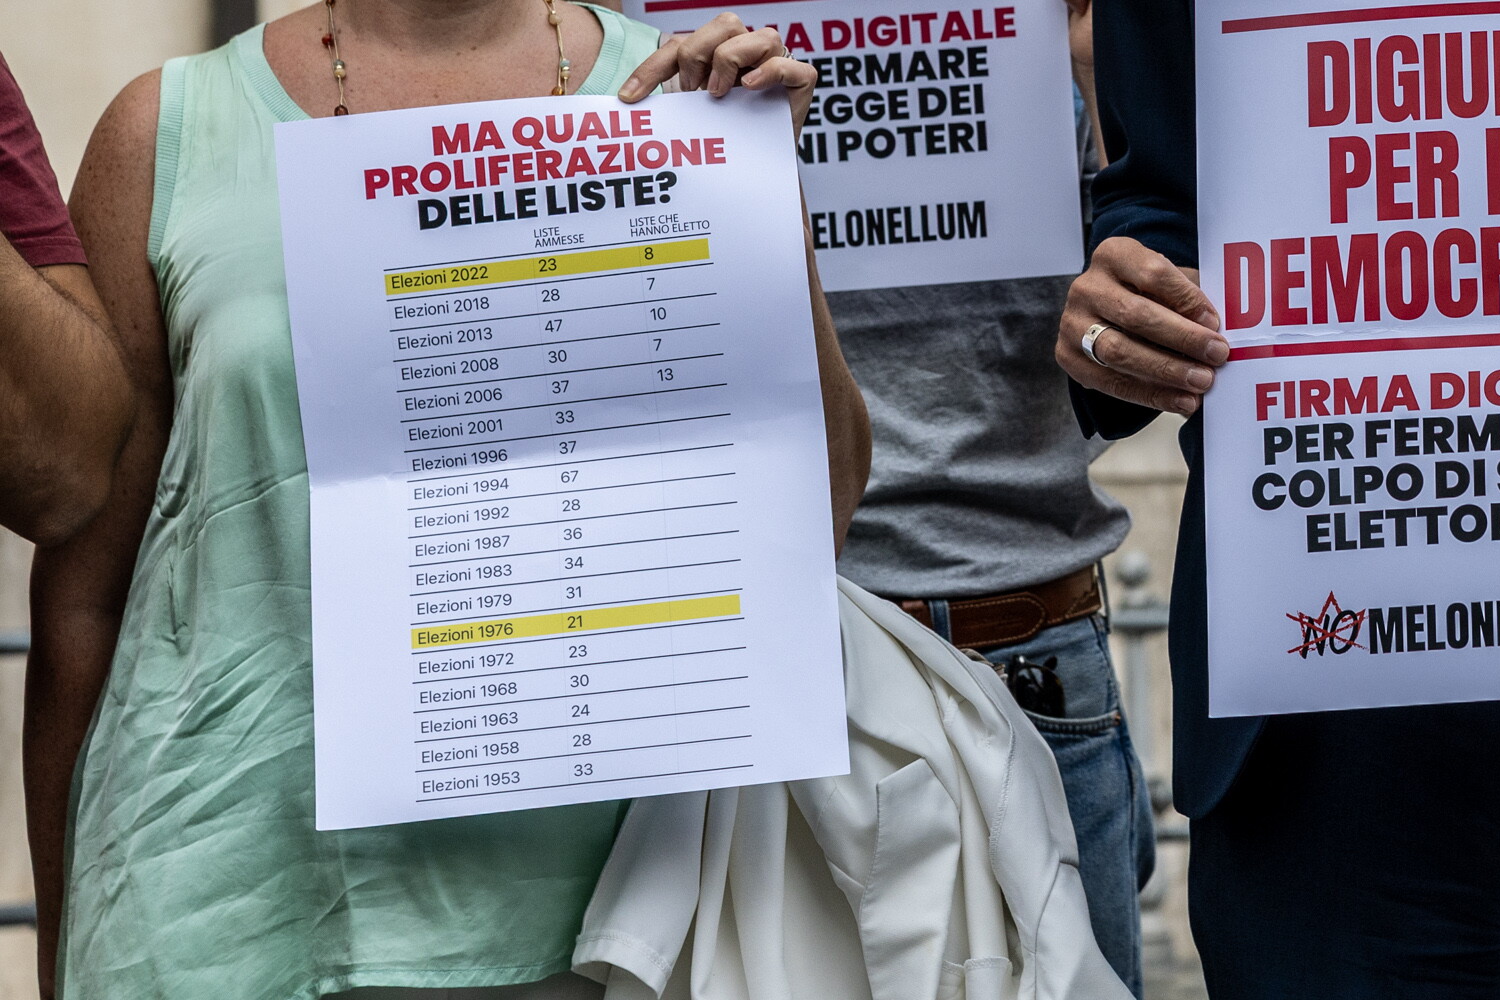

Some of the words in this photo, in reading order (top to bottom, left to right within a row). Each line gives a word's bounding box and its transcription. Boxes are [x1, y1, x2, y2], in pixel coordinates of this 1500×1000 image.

[822, 6, 1016, 51] DIGITALE
[797, 45, 989, 88] ERMARE
[804, 88, 910, 127] EGGE
[918, 83, 985, 118] DEI
[432, 121, 505, 156] MA
[512, 110, 652, 150] QUALE
[837, 120, 988, 162] POTERI
[364, 138, 726, 200] PROLIFERAZIONE
[1329, 131, 1459, 224] PER
[418, 187, 538, 230] DELLE
[546, 171, 677, 216] LISTE?
[629, 215, 656, 228] LISTE
[657, 213, 680, 225] CHE
[533, 226, 561, 239] LISTE
[534, 233, 585, 249] AMMESSE
[630, 224, 670, 238] HANNO
[671, 219, 710, 233] ELETTO
[811, 201, 988, 250] ELONELLUM
[391, 270, 447, 290] Elezioni
[450, 265, 489, 283] 2022
[538, 257, 558, 273] 23
[643, 246, 655, 261] 8
[394, 300, 450, 320] Elezioni
[453, 296, 490, 313] 2018
[541, 288, 561, 303] 28
[646, 277, 656, 291] 7
[397, 330, 453, 350] Elezioni
[456, 326, 493, 344] 2013
[544, 318, 563, 333] 47
[649, 306, 667, 321] 10
[400, 361, 457, 381] Elezioni
[460, 357, 500, 374] 2008
[547, 349, 568, 364] 30
[652, 338, 662, 352] 7
[404, 391, 460, 411] Elezioni
[463, 387, 503, 405] 2006
[551, 379, 570, 395] 37
[656, 367, 674, 382] 13
[1256, 375, 1420, 421] FIRMA
[408, 422, 464, 442] Elezioni
[467, 418, 503, 435] 2001
[555, 409, 575, 425] 33
[1264, 423, 1354, 465] PER
[411, 452, 468, 472] Elezioni
[470, 448, 508, 465] 1996
[558, 440, 577, 455] 37
[414, 480, 469, 500] Elezioni
[472, 477, 509, 493] 1994
[560, 470, 579, 484] 67
[1252, 463, 1423, 510] COLPO
[1435, 459, 1486, 499] DI
[414, 509, 469, 529] Elezioni
[473, 506, 510, 521] 1992
[562, 498, 581, 513] 28
[415, 537, 470, 557] Elezioni
[474, 534, 510, 550] 1987
[563, 527, 583, 541] 36
[415, 567, 471, 587] Elezioni
[475, 563, 513, 580] 1983
[564, 556, 584, 570] 34
[416, 596, 472, 616] Elezioni
[476, 593, 513, 609] 1979
[566, 585, 582, 600] 31
[417, 625, 474, 645] Elezioni
[477, 622, 514, 639] 1976
[567, 614, 583, 629] 21
[1300, 609, 1360, 660] NO
[418, 655, 475, 675] Elezioni
[479, 652, 514, 668] 1972
[568, 644, 588, 659] 23
[419, 684, 476, 704] Elezioni
[480, 681, 518, 698] 1968
[570, 673, 590, 688] 30
[420, 714, 477, 734] Elezioni
[481, 711, 519, 727] 1963
[571, 703, 591, 718] 24
[421, 744, 478, 764] Elezioni
[482, 741, 520, 757] 1958
[572, 733, 592, 748] 28
[422, 774, 479, 794] Elezioni
[483, 770, 521, 787] 1953
[573, 762, 594, 777] 33
